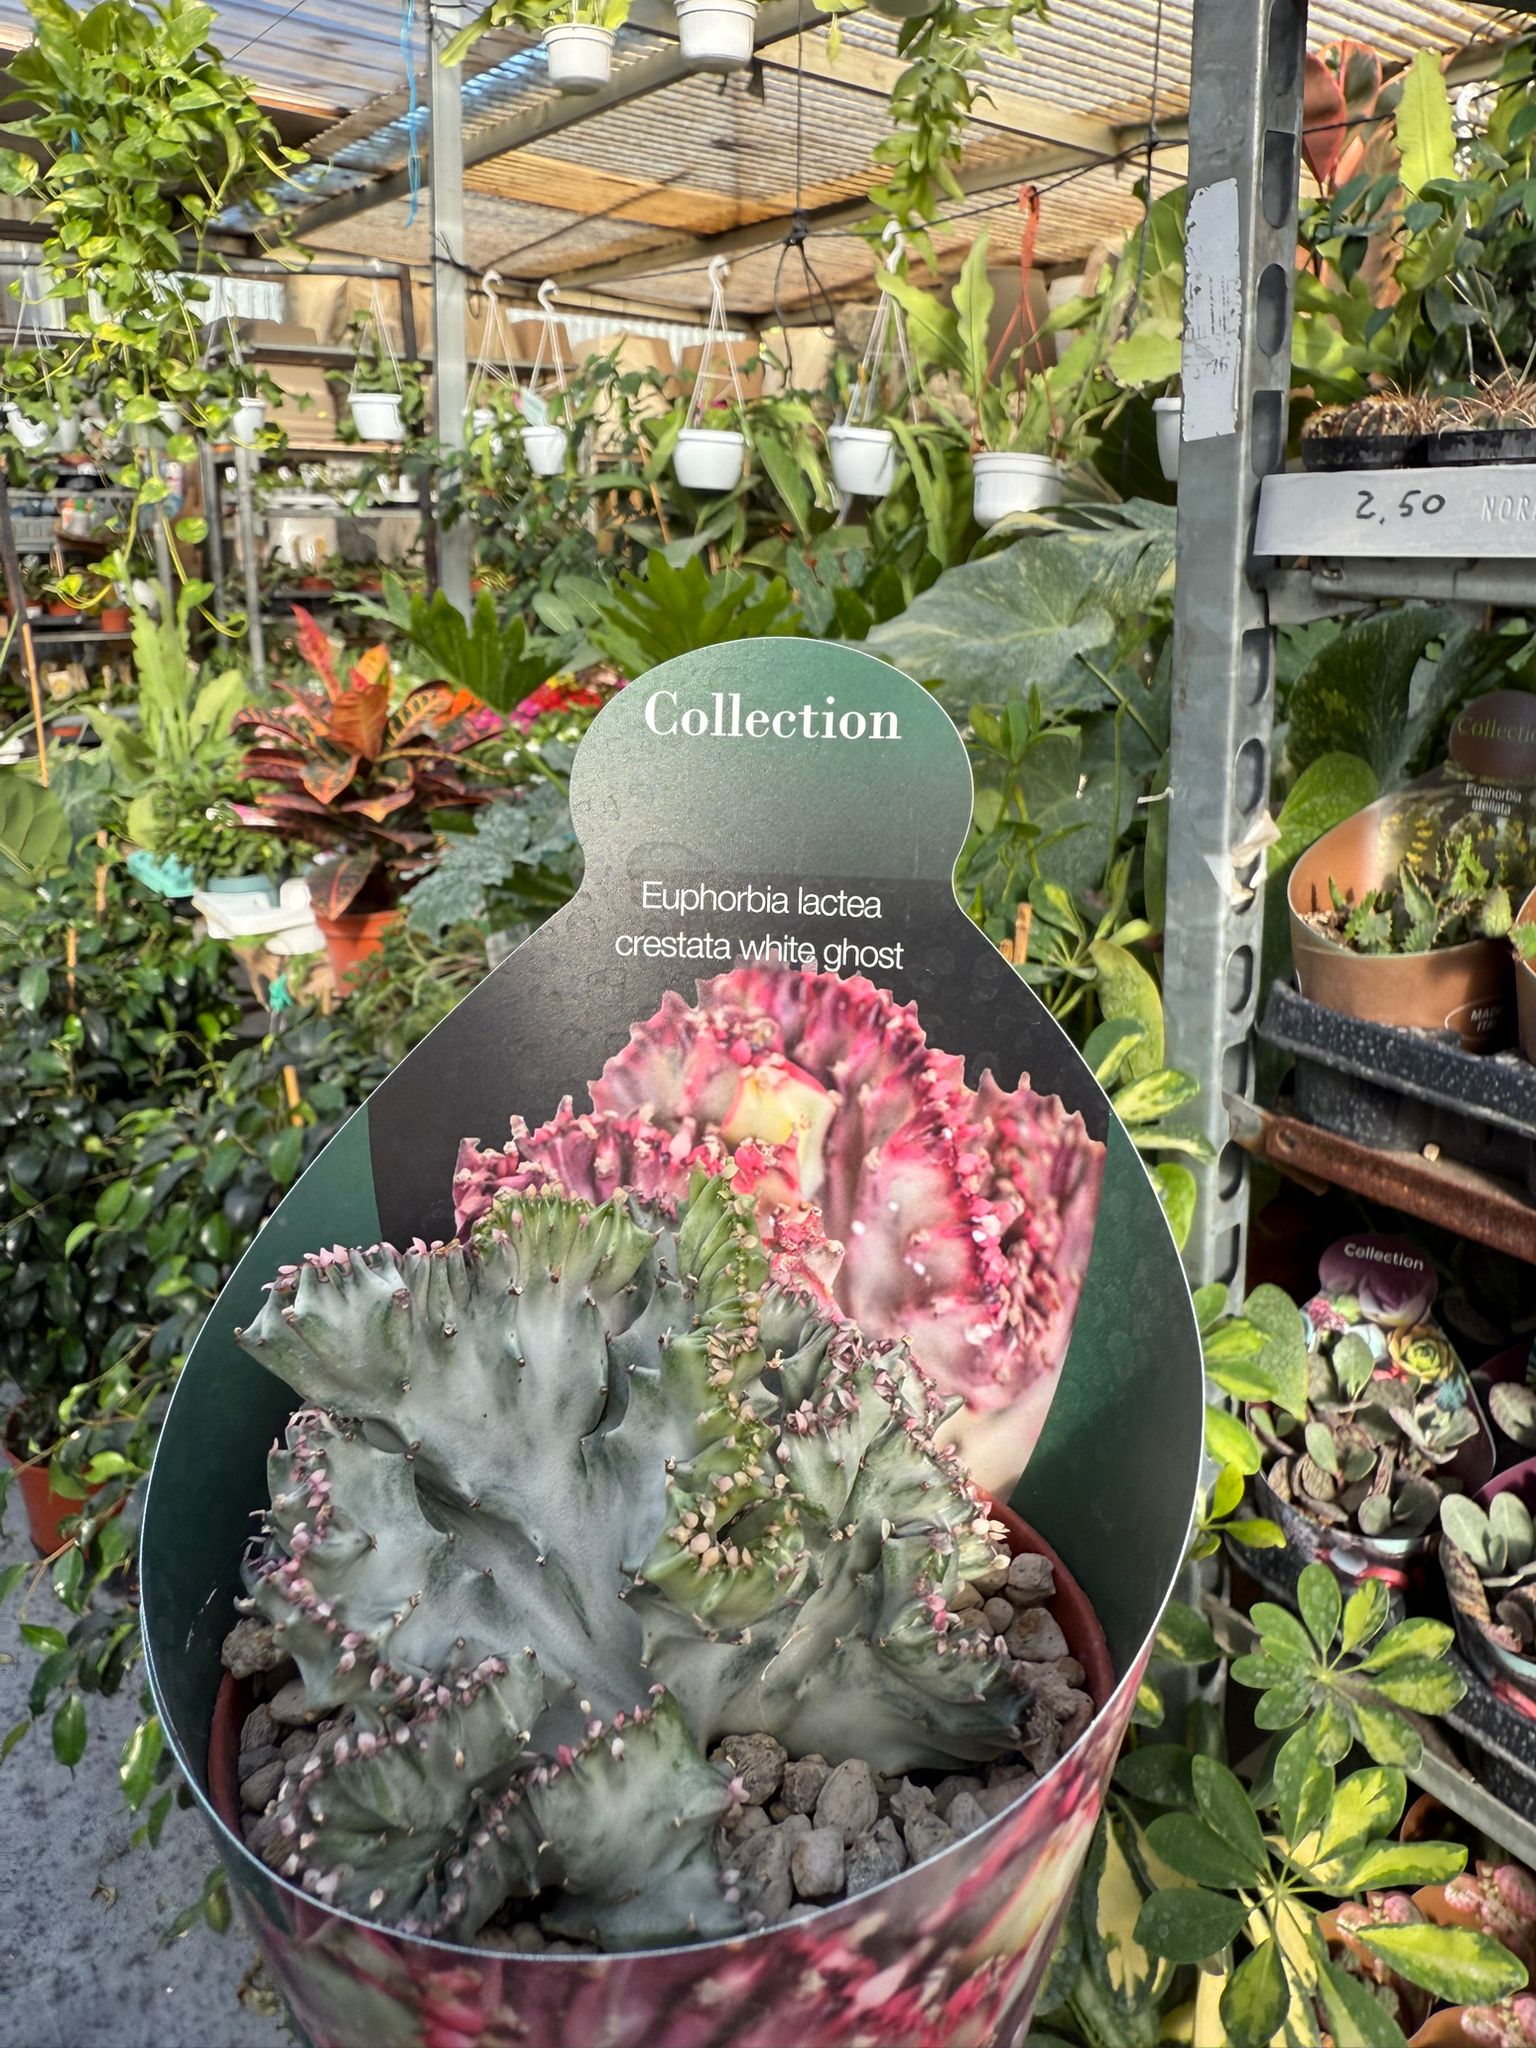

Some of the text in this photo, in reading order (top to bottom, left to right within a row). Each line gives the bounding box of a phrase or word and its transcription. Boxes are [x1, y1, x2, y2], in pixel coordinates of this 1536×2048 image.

[1481, 495, 1536, 522] NOR
[643, 690, 902, 740] Collection
[642, 880, 882, 919] Euphorbia lactea
[614, 931, 905, 973] crestata white ghost
[1343, 1242, 1425, 1272] Collection
